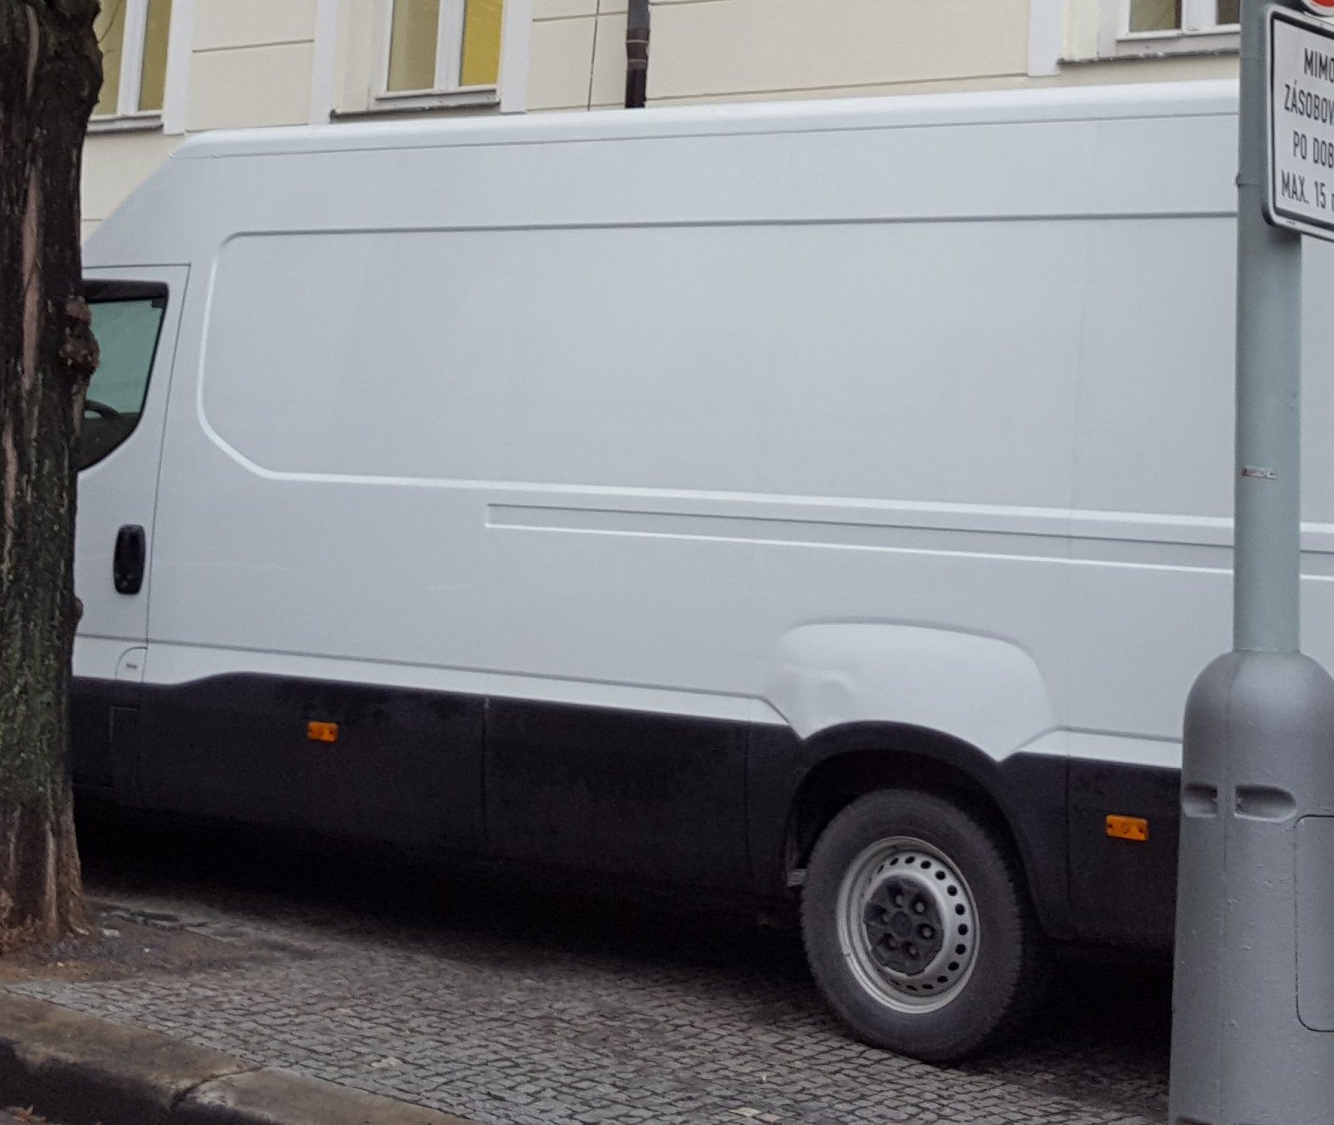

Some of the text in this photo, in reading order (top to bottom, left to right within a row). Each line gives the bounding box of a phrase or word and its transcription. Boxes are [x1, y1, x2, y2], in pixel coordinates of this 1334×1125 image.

[1292, 130, 1308, 161] PO
[1281, 169, 1310, 205] MAX.
[1314, 180, 1327, 209] 15
